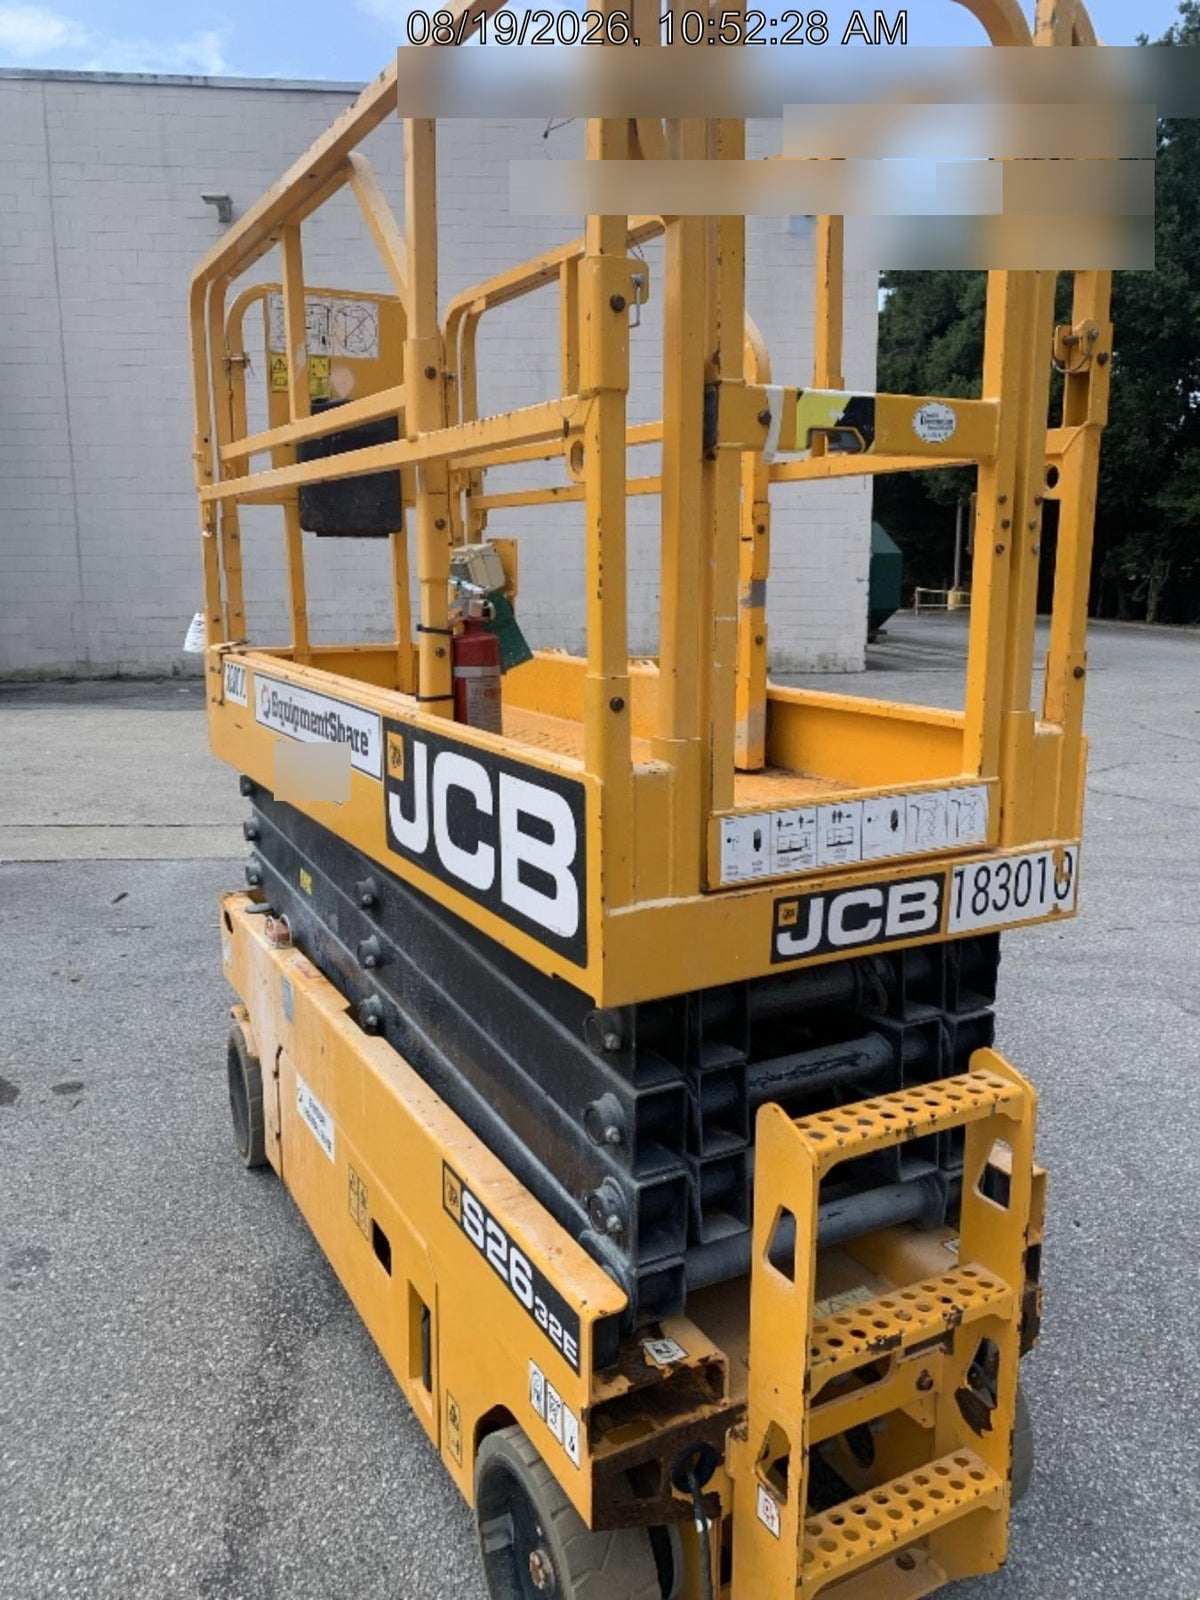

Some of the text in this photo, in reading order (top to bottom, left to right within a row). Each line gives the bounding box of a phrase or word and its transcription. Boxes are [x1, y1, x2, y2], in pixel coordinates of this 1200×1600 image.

[271, 690, 370, 757] EquipmentShare
[388, 740, 579, 938] JCB
[776, 877, 940, 956] JCB
[954, 850, 1073, 919] 183010
